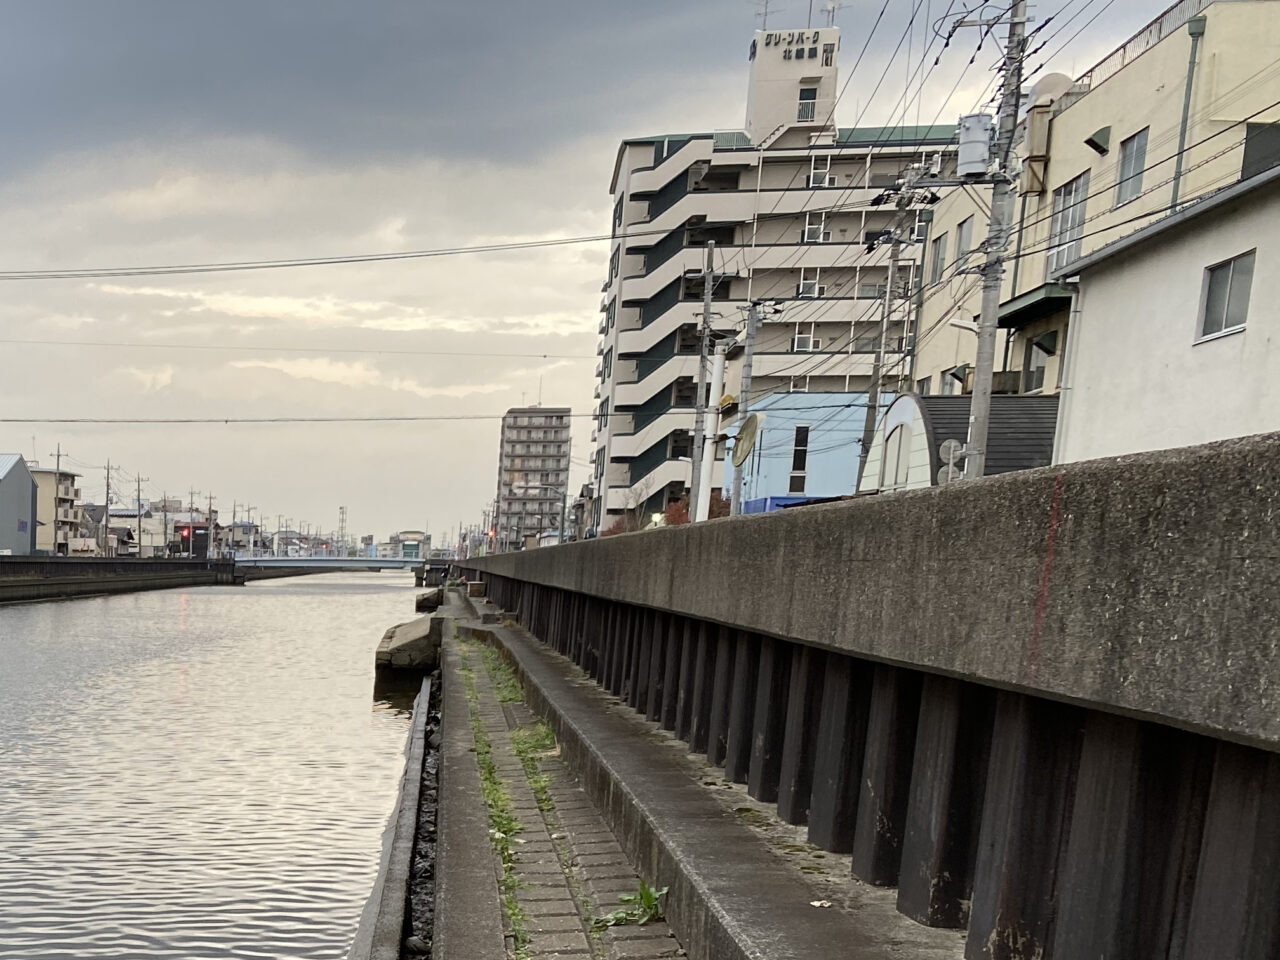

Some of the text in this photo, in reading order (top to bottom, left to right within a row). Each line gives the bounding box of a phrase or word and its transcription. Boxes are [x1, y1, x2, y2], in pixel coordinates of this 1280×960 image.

[765, 31, 819, 47] グリーンパーク
